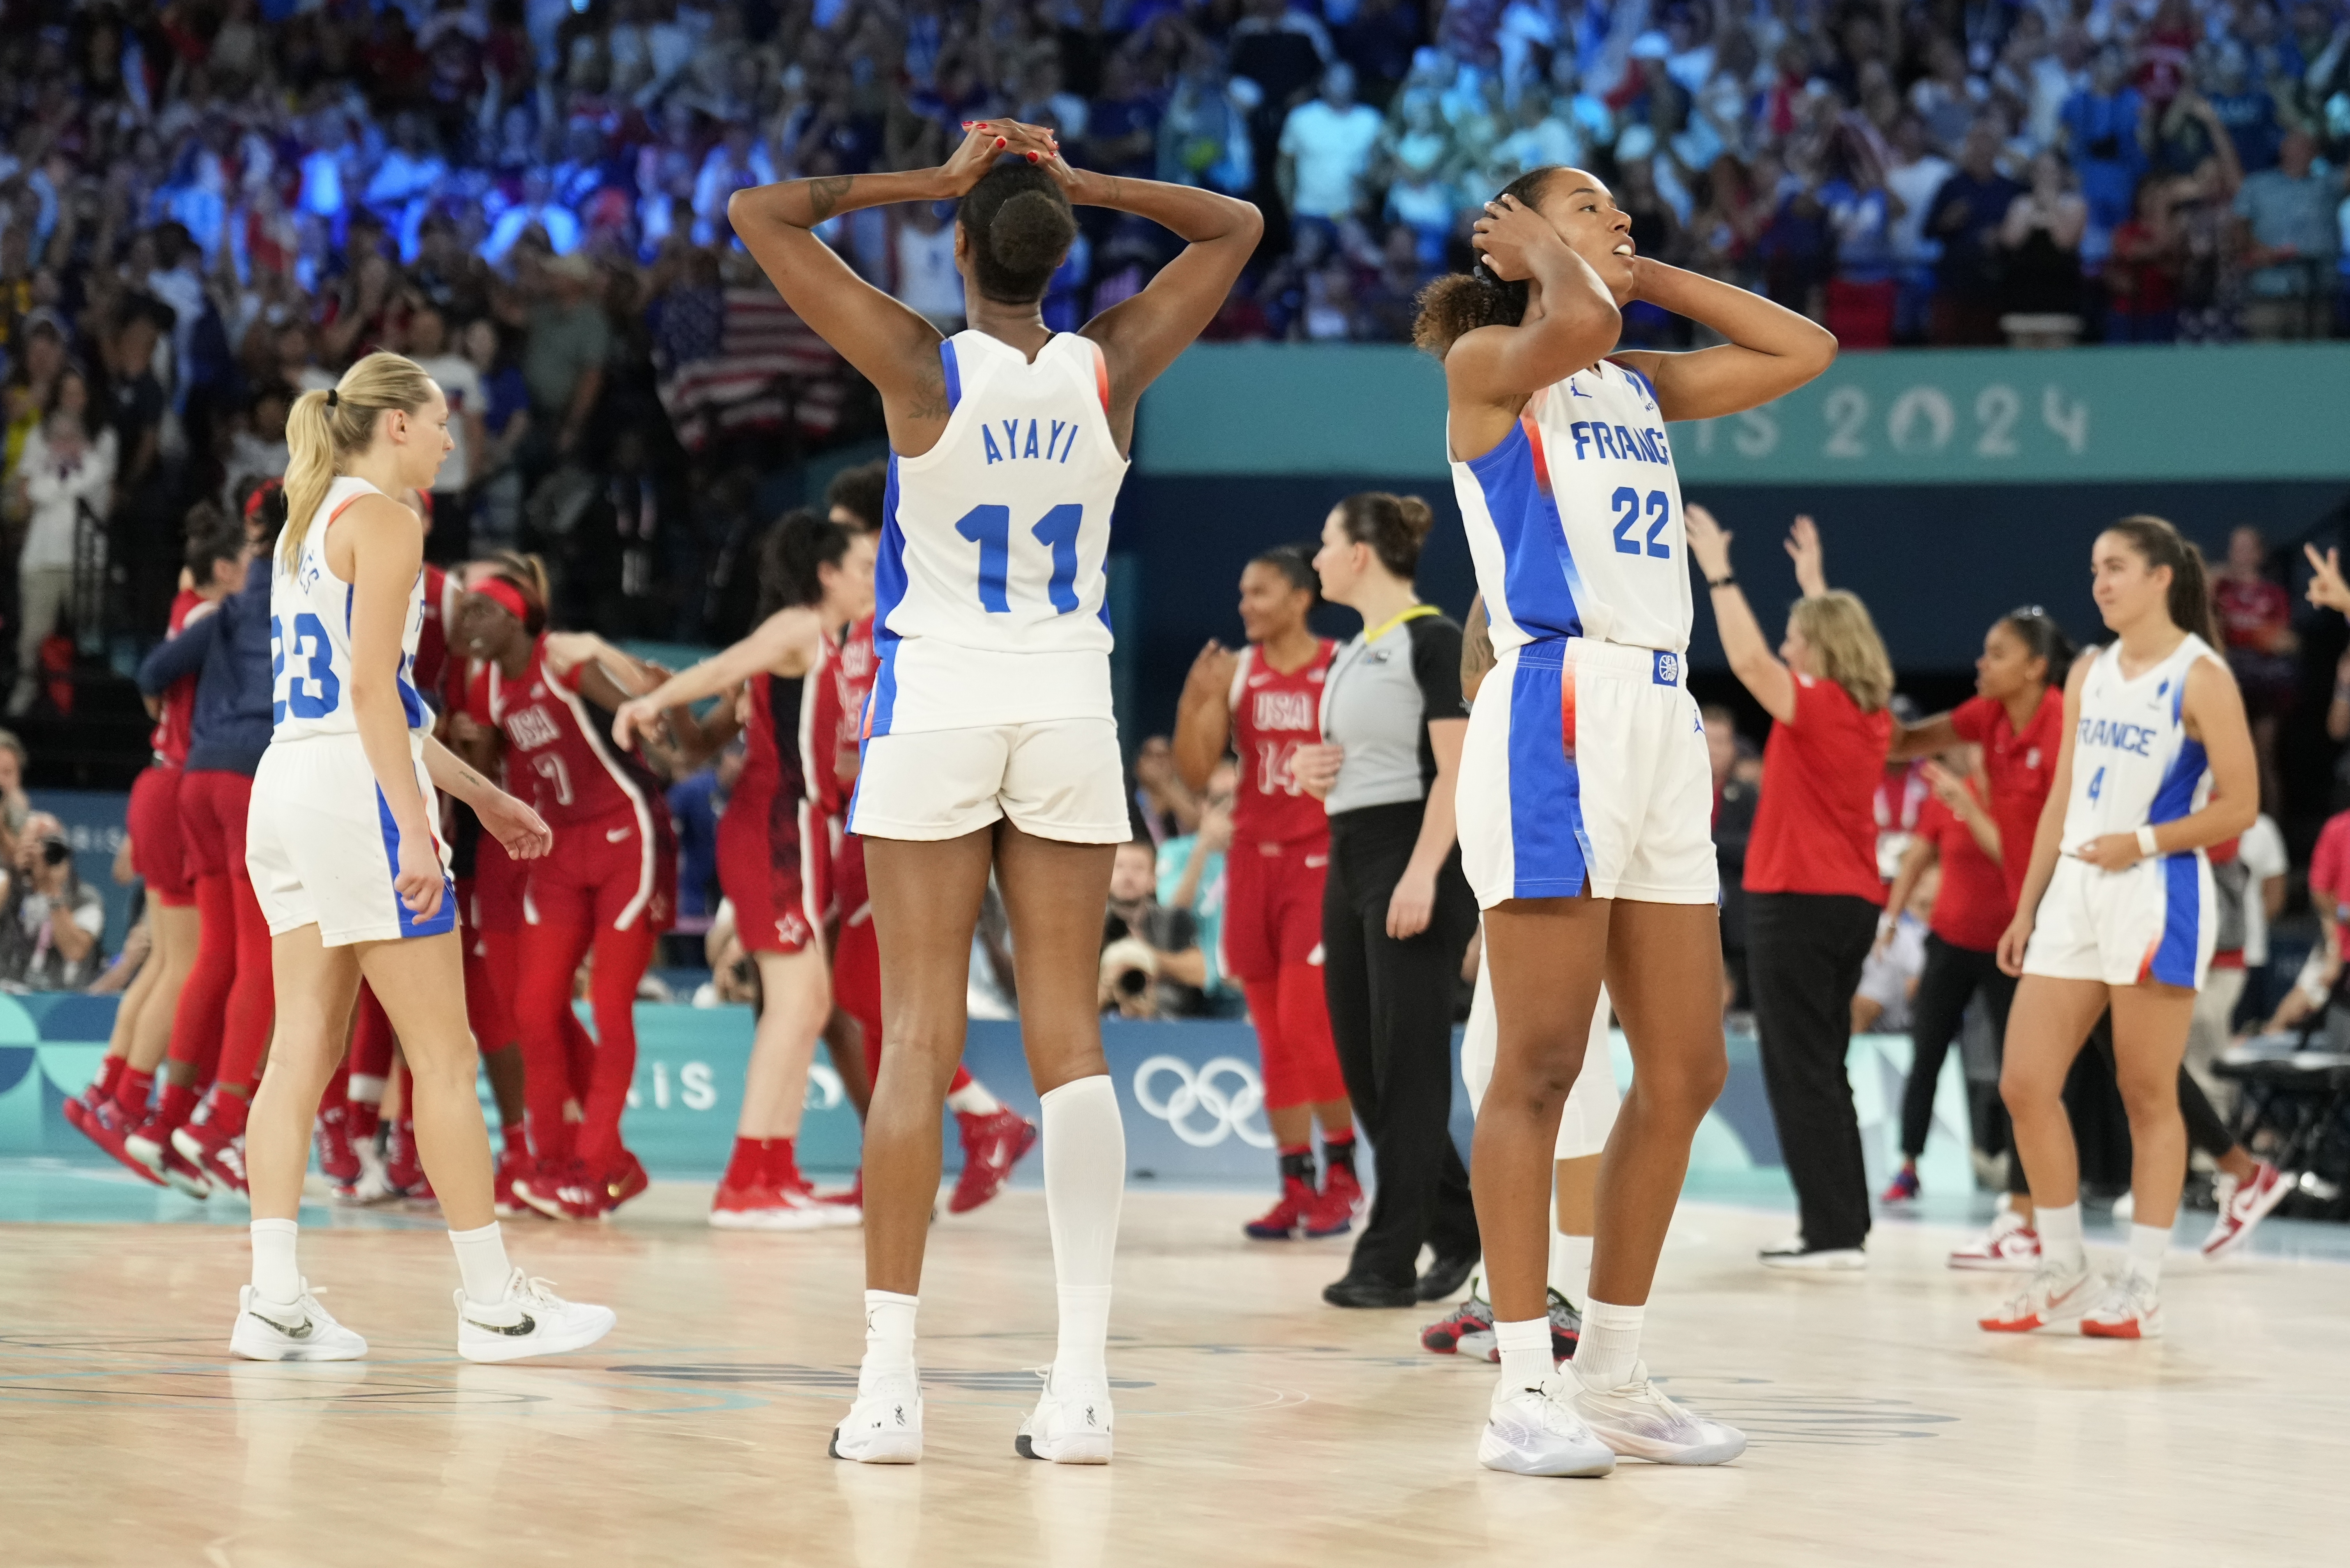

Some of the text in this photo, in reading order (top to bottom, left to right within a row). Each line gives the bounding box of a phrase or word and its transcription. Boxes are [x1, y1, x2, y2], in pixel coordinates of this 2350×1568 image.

[981, 418, 1078, 465] AYAYI
[1570, 421, 1670, 467] FRANC
[1824, 385, 2089, 457] 2024
[1612, 486, 1670, 559] 22
[954, 504, 1083, 615] 11
[271, 613, 340, 726] 23
[504, 705, 561, 752] USA
[1252, 691, 1314, 732] USA
[2076, 719, 2157, 757] RANCE
[2088, 766, 2106, 808] 4
